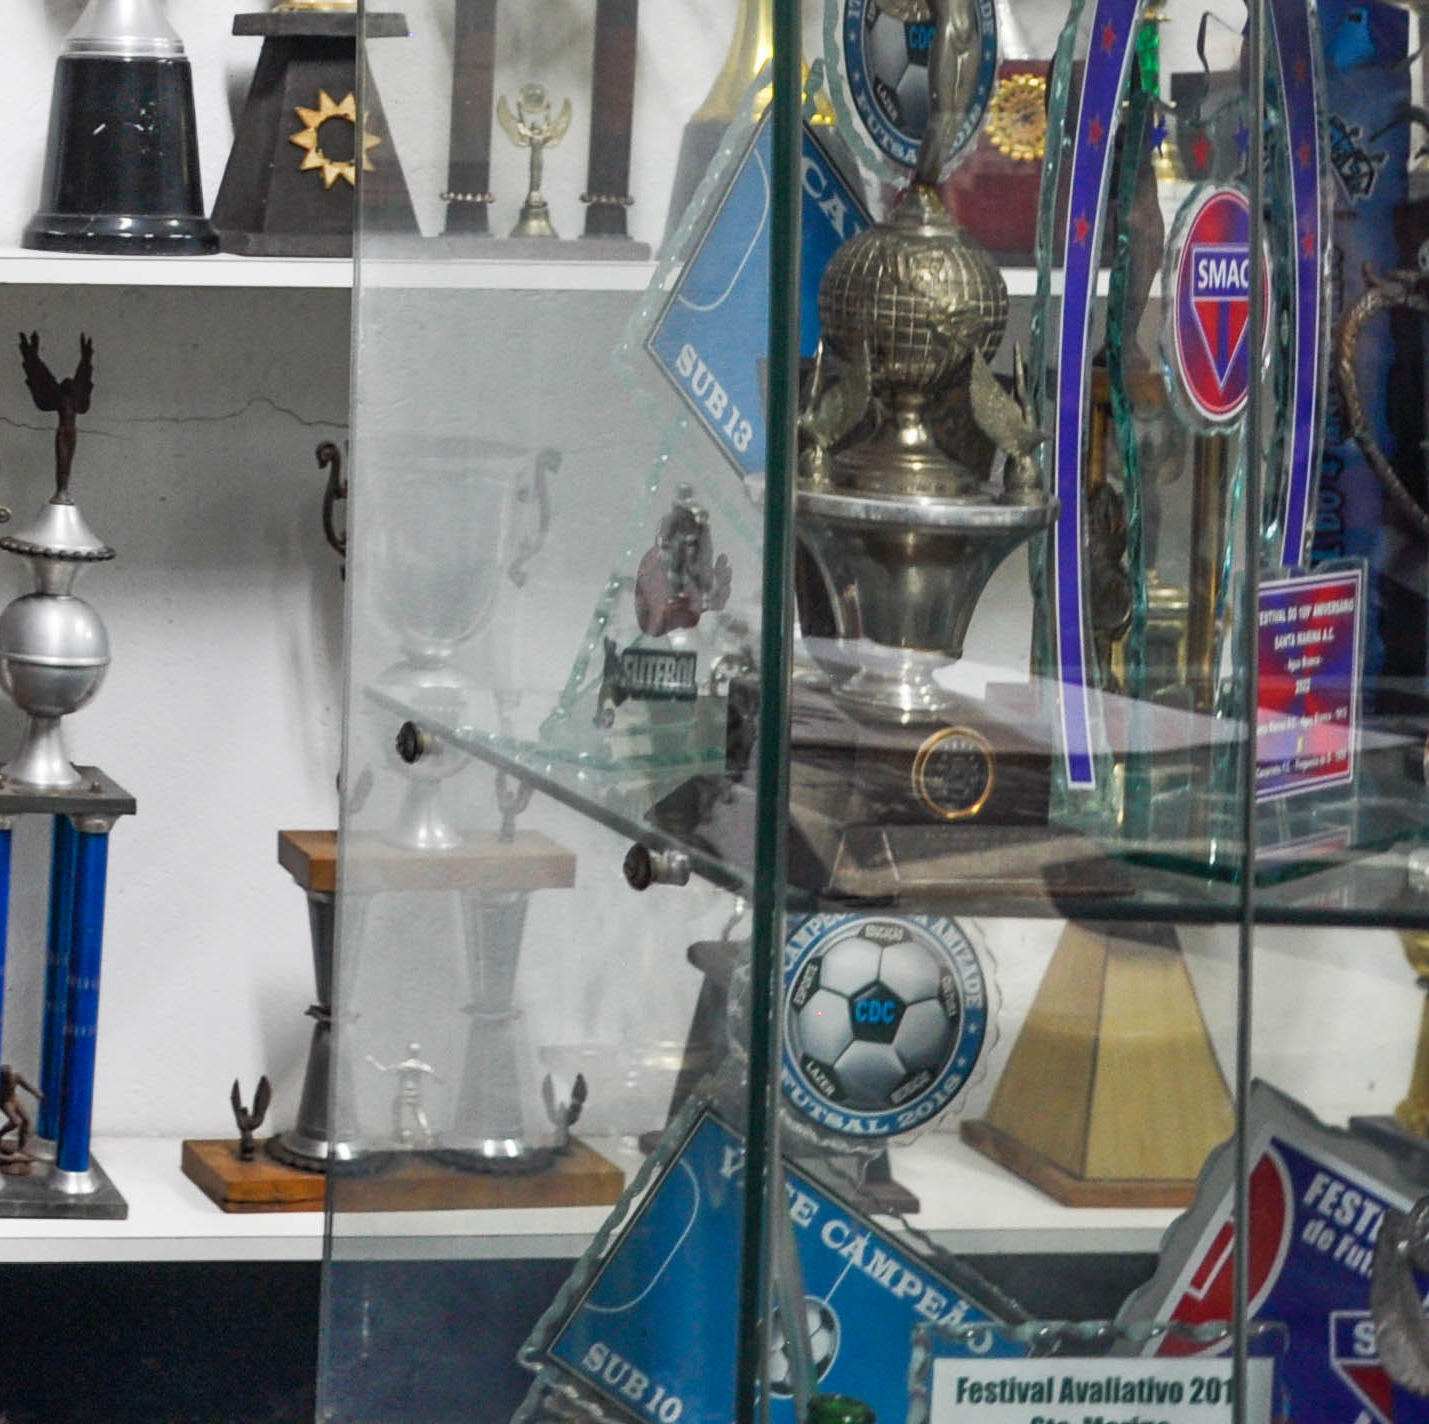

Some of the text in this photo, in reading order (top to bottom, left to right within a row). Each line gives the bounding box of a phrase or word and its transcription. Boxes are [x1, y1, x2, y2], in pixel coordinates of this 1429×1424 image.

[675, 342, 754, 453] SUB 13
[854, 999, 897, 1025] CDC
[804, 1060, 837, 1099] LAZER
[1301, 1221, 1333, 1252] de
[580, 1340, 684, 1424] SUB 10
[955, 1375, 1236, 1405] Festival Avaliativo 201
